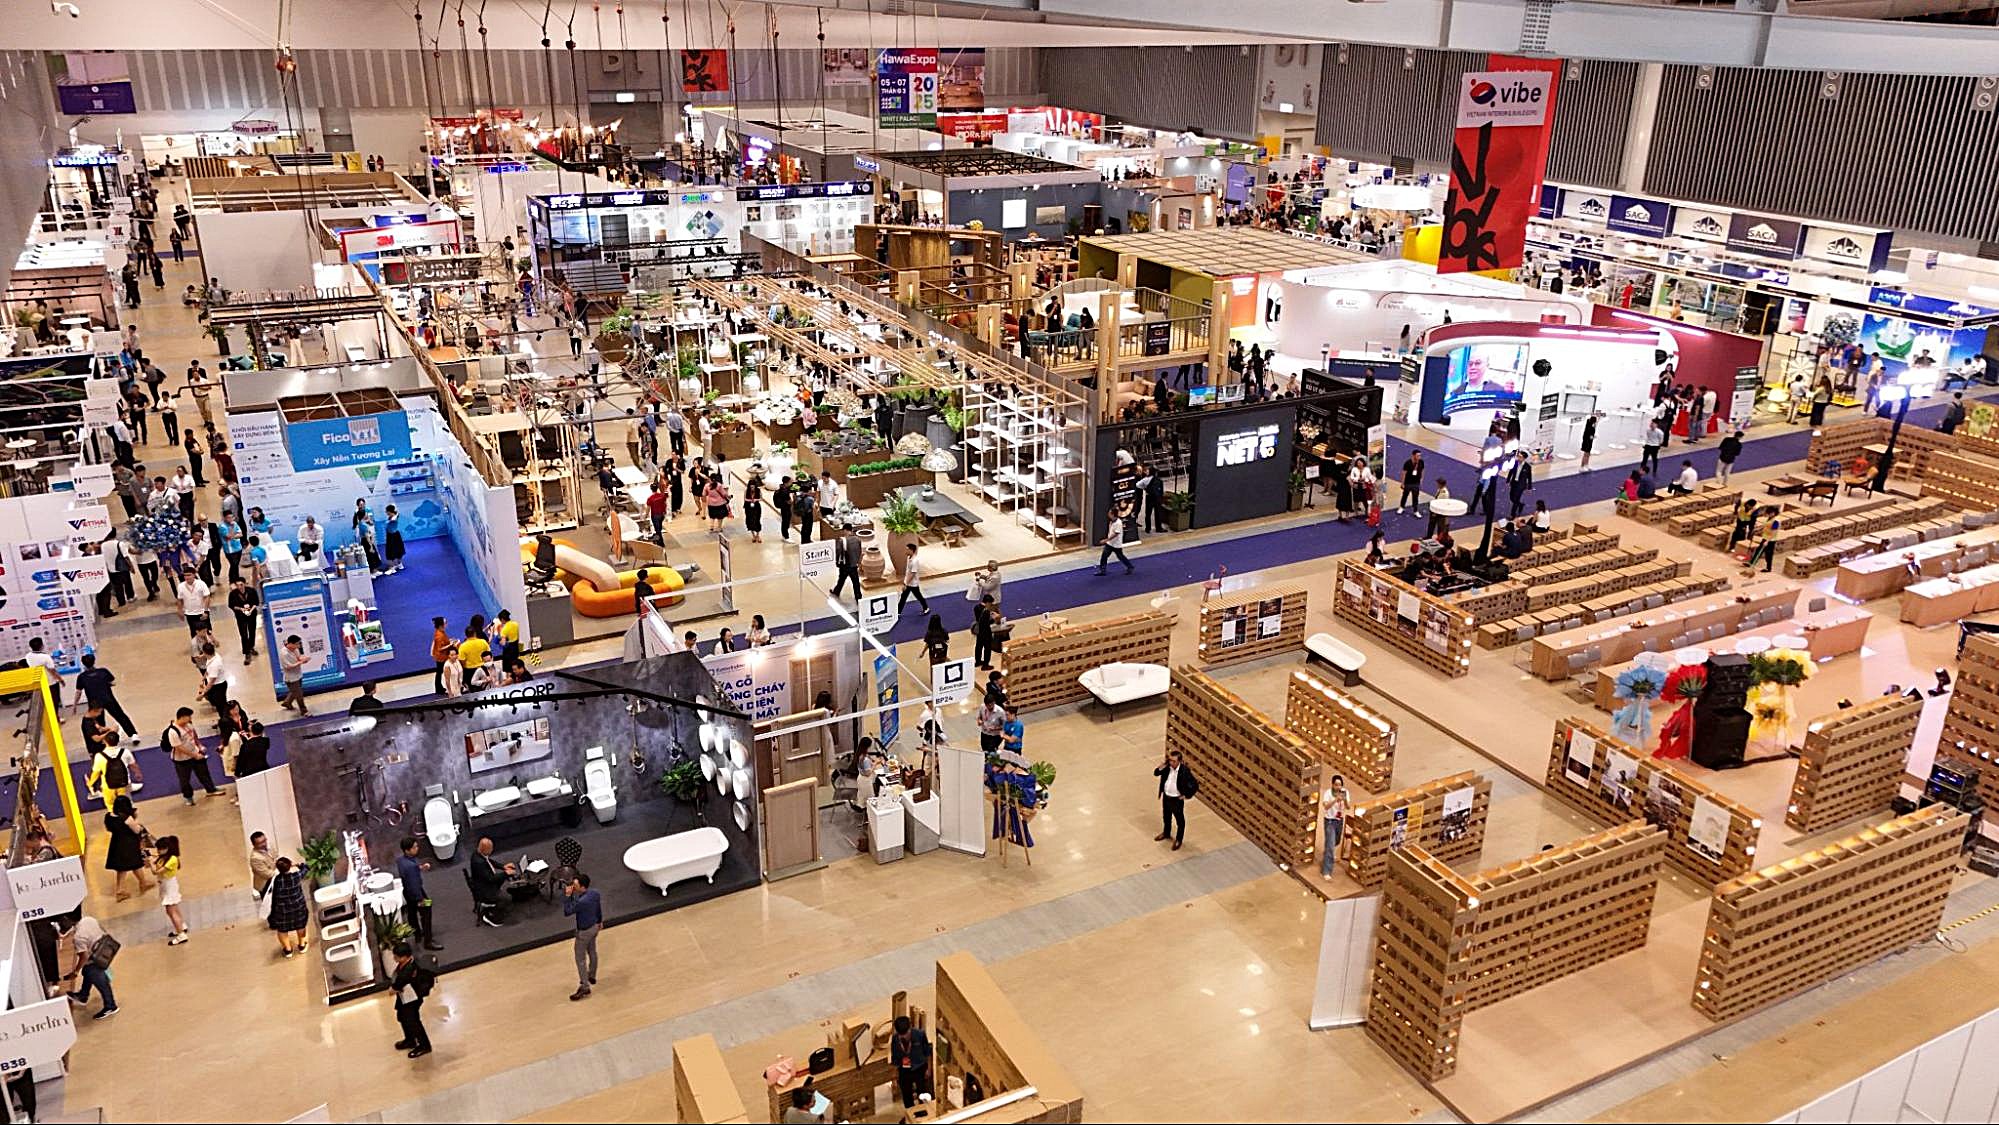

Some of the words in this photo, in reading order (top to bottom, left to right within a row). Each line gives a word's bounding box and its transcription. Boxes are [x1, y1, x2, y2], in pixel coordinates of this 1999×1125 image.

[880, 54, 936, 66] HawaExpo
[881, 79, 891, 87] 05
[897, 79, 906, 87] 07
[914, 76, 934, 92] 20
[1501, 81, 1542, 103] vibe
[1625, 209, 1650, 221] SACA
[376, 234, 395, 246] 3M
[1747, 229, 1776, 241] SACA
[1826, 243, 1862, 258] SACA
[322, 433, 350, 445] Fico
[313, 456, 330, 465] Xây
[352, 451, 381, 461] Tương
[382, 448, 395, 456] Lai
[805, 549, 830, 560] Stark
[755, 682, 785, 696] CHÁY
[746, 696, 775, 710] DIỆN
[22, 907, 45, 919] B38
[0, 1057, 27, 1071] B38
